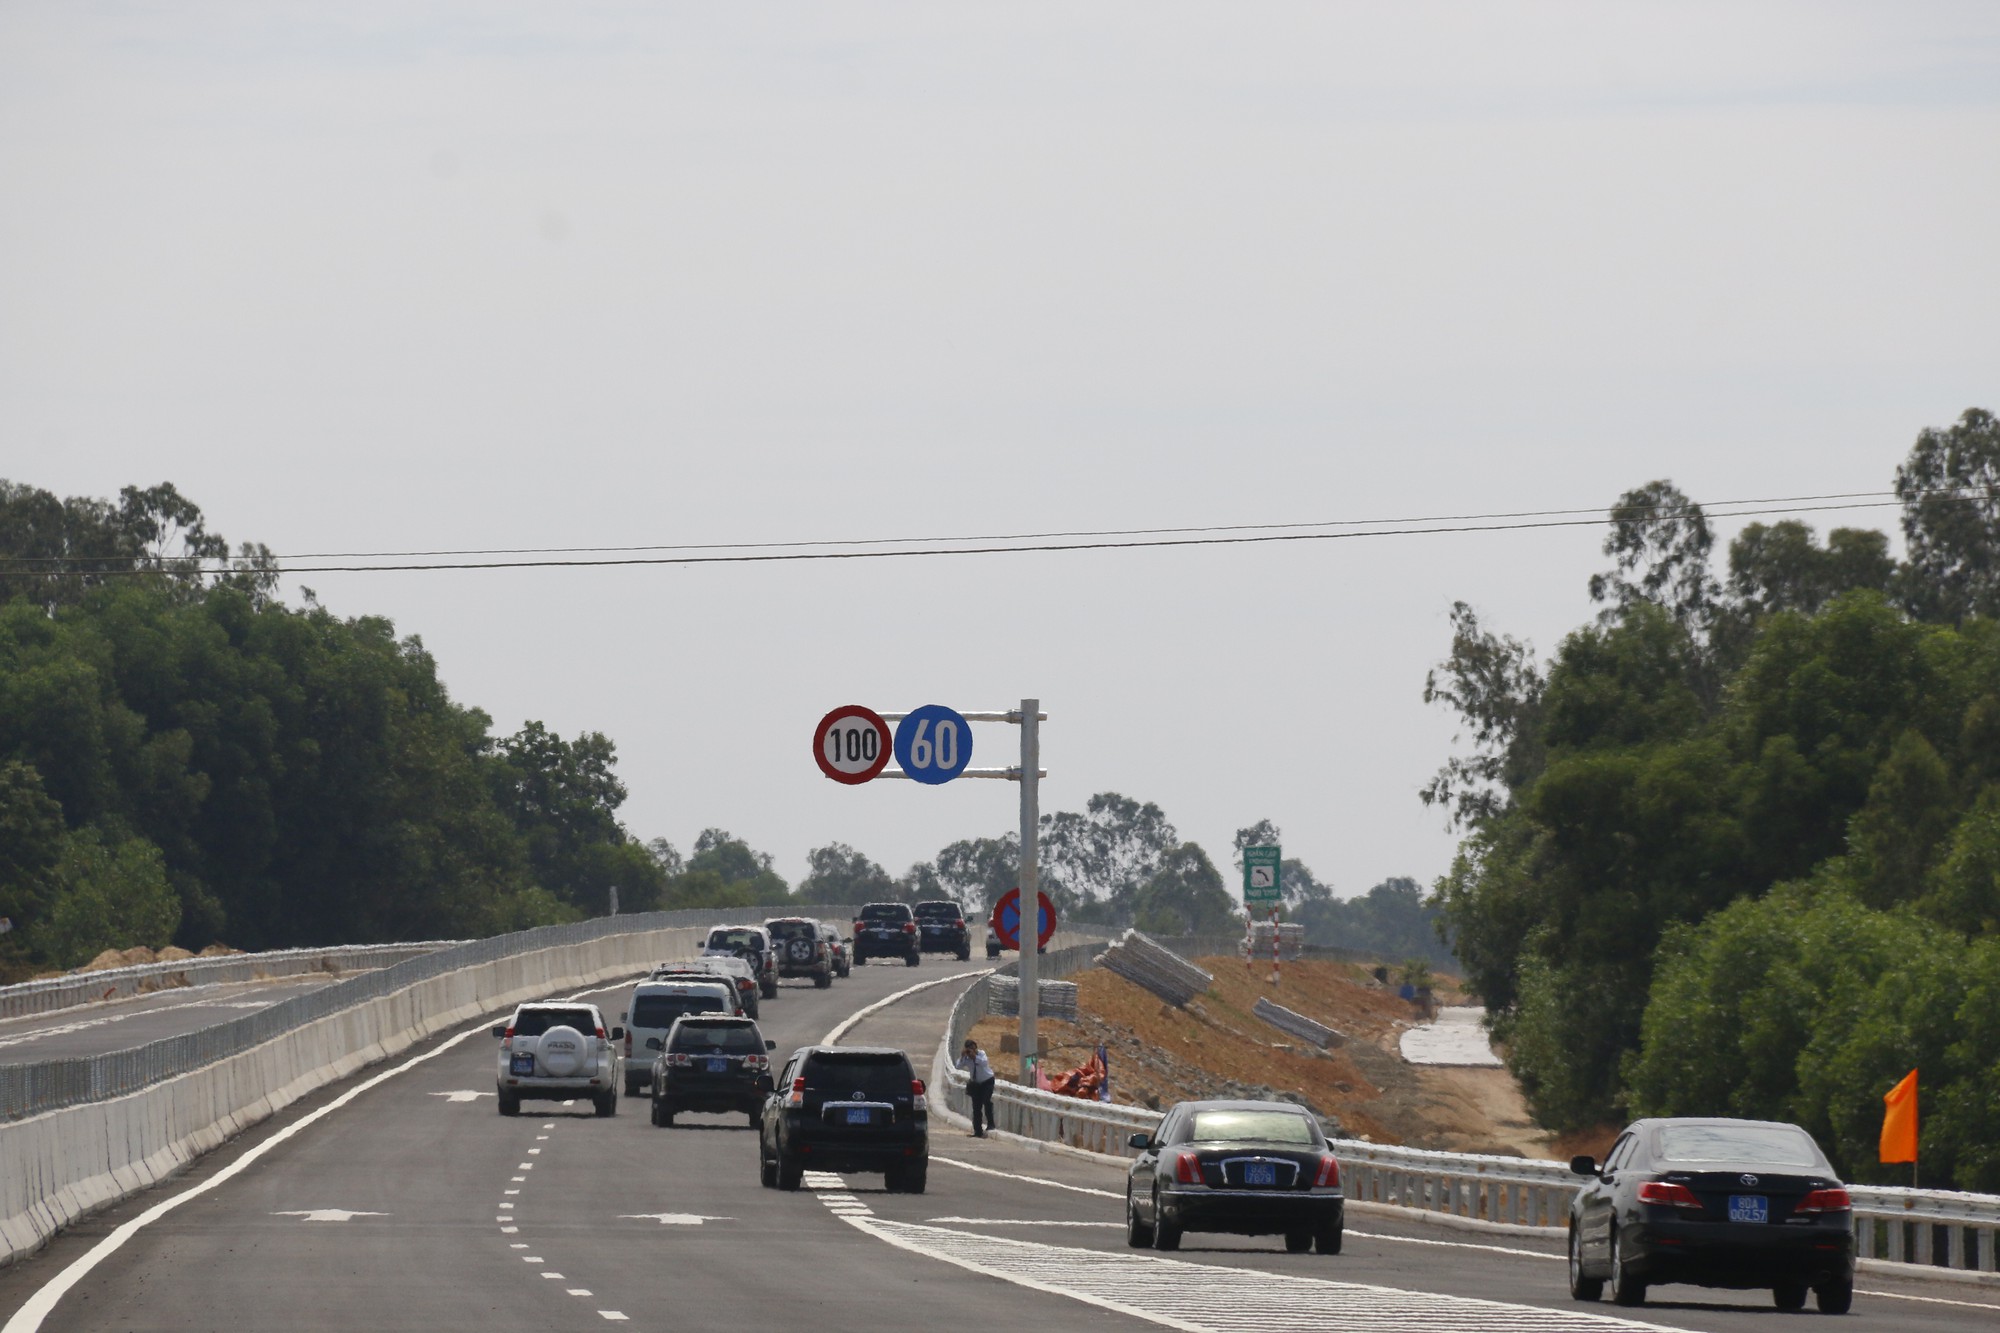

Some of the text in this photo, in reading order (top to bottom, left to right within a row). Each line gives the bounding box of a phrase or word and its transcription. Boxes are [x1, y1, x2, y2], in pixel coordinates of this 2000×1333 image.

[830, 728, 877, 762] 100
[910, 719, 958, 770] 60
[1738, 1197, 1759, 1209] 80A
